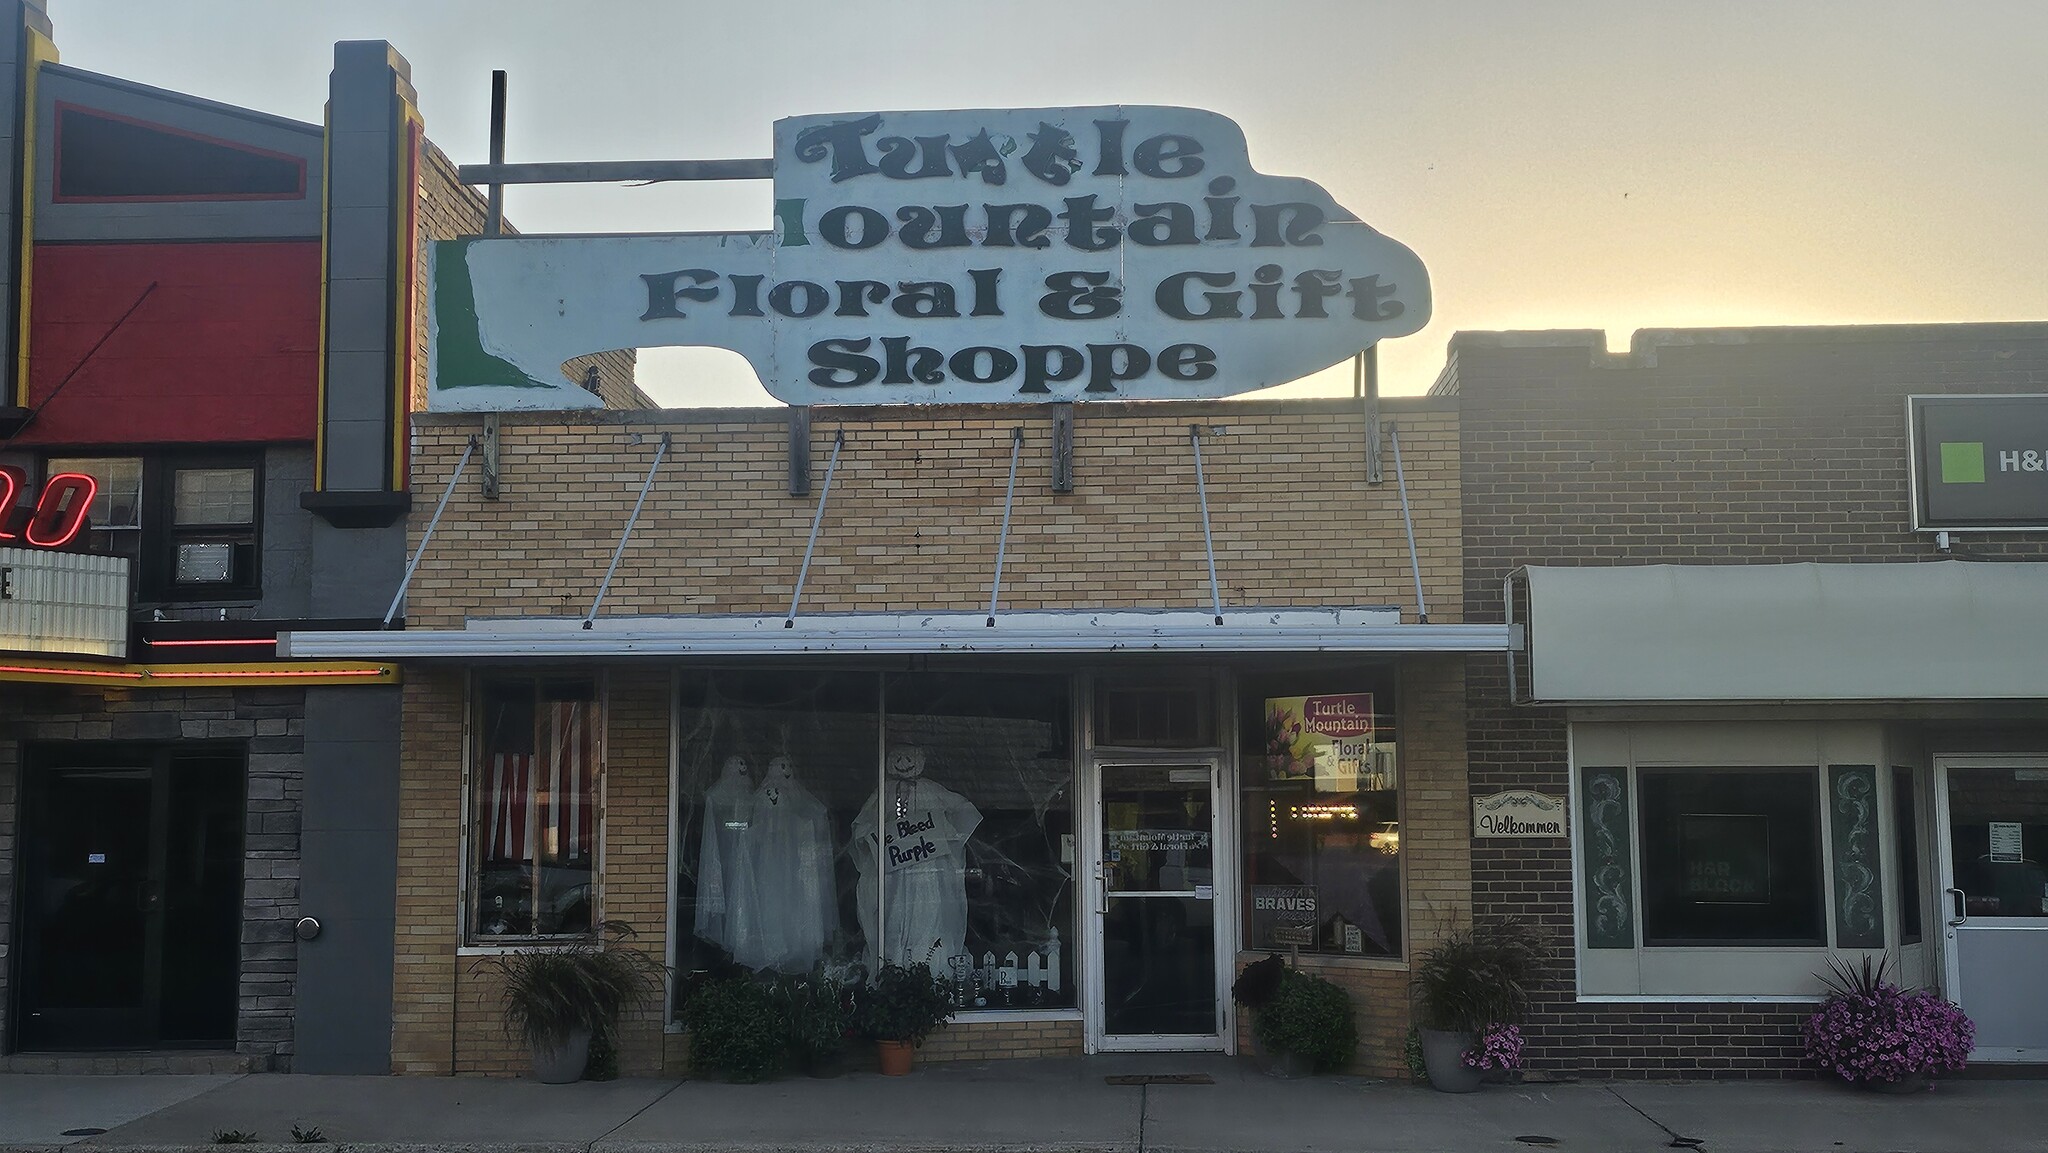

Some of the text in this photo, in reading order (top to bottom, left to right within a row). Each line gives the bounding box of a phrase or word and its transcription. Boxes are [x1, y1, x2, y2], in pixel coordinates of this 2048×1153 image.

[795, 113, 1205, 185] Turtle
[639, 264, 1405, 321] Floral & Gift
[807, 336, 1217, 393] Shoppe
[2000, 450, 2048, 472] H&
[1312, 700, 1356, 716] Turtle
[1305, 715, 1368, 733] Mountain
[1332, 738, 1371, 756] Floral
[1337, 758, 1372, 774] Gifts
[896, 812, 936, 838] Bleed
[1480, 815, 1561, 835] Velkommen
[888, 836, 937, 866] Purple
[1255, 897, 1317, 912] BRAVES
